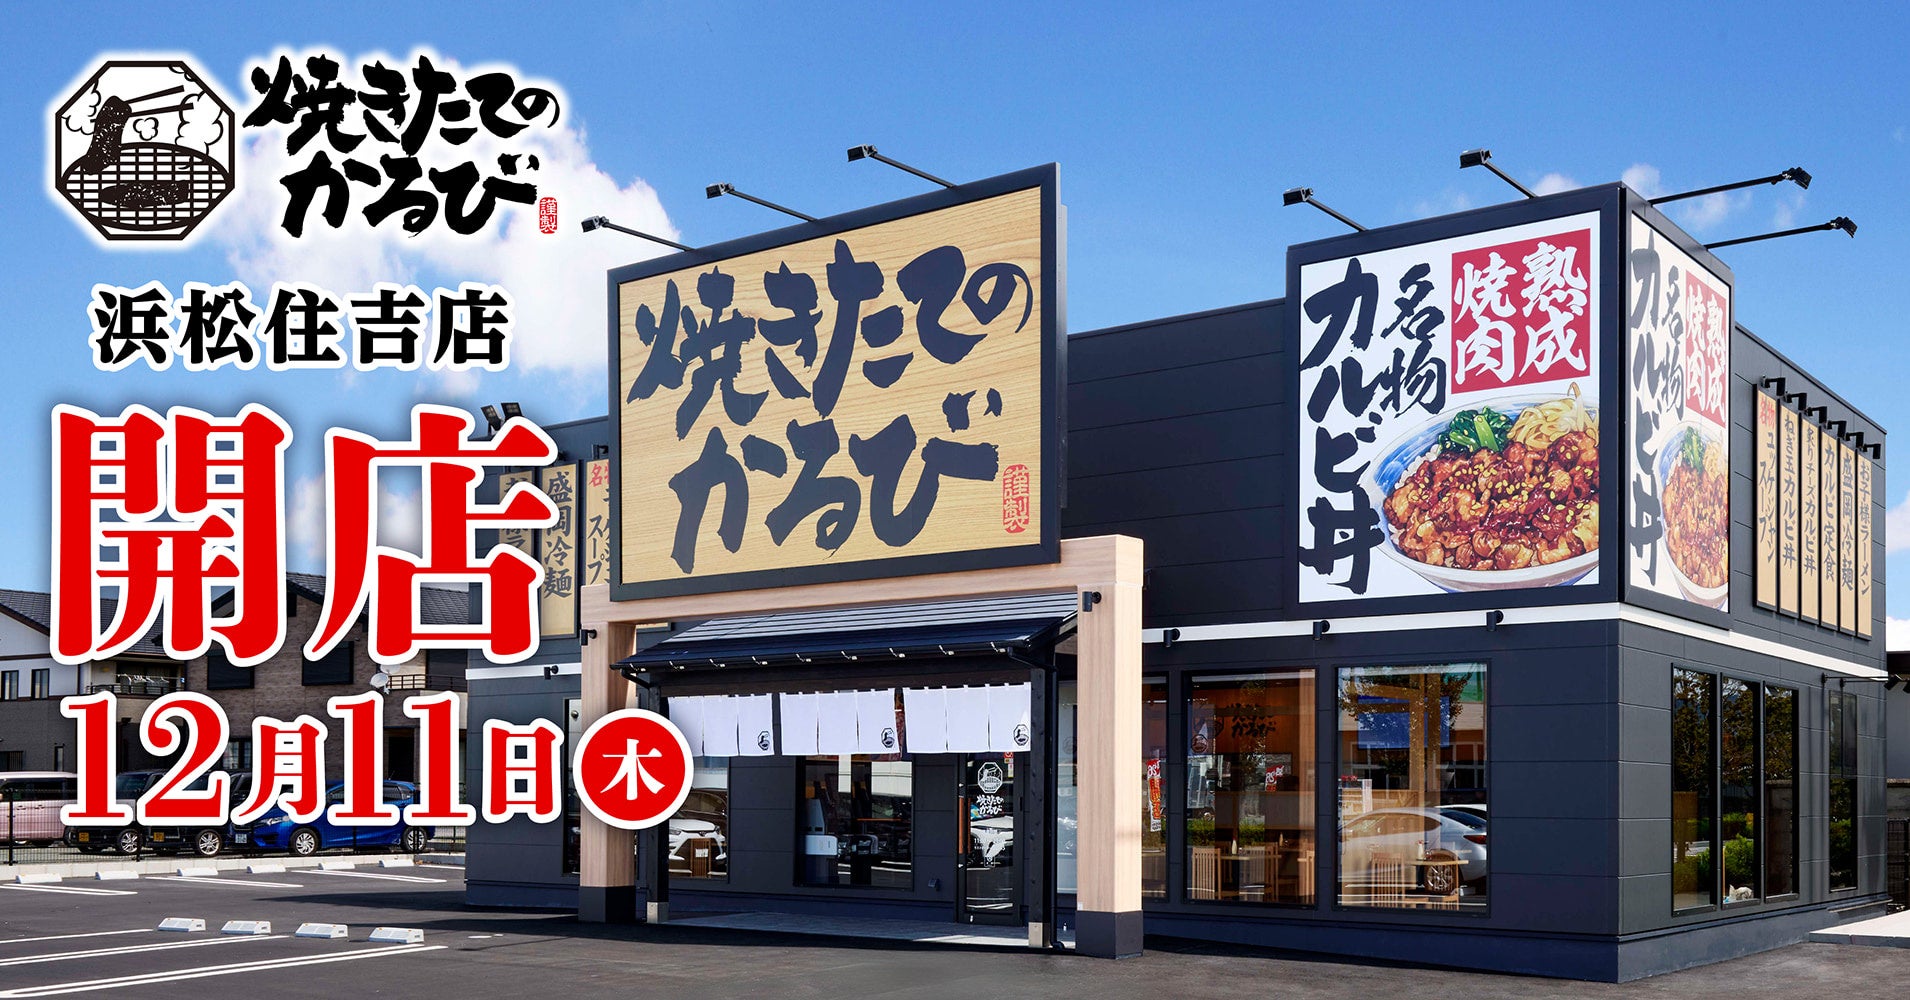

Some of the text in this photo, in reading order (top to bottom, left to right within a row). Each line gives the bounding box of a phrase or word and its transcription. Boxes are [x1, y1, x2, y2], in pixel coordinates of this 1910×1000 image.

[627, 239, 1033, 441] 焼きたての
[1381, 262, 1447, 418] 名物
[1454, 251, 1517, 386] 焼肉
[1520, 241, 1588, 377] 熟成
[1662, 265, 1684, 421] 名物
[1686, 284, 1706, 413] 焼肉
[1706, 293, 1727, 424] 熟成
[668, 387, 1003, 574] かるび
[1300, 257, 1385, 595] カルビ丼
[1630, 229, 1663, 586] カルビ丼
[587, 514, 605, 585] スープ
[1823, 442, 1836, 582] カルビ定食
